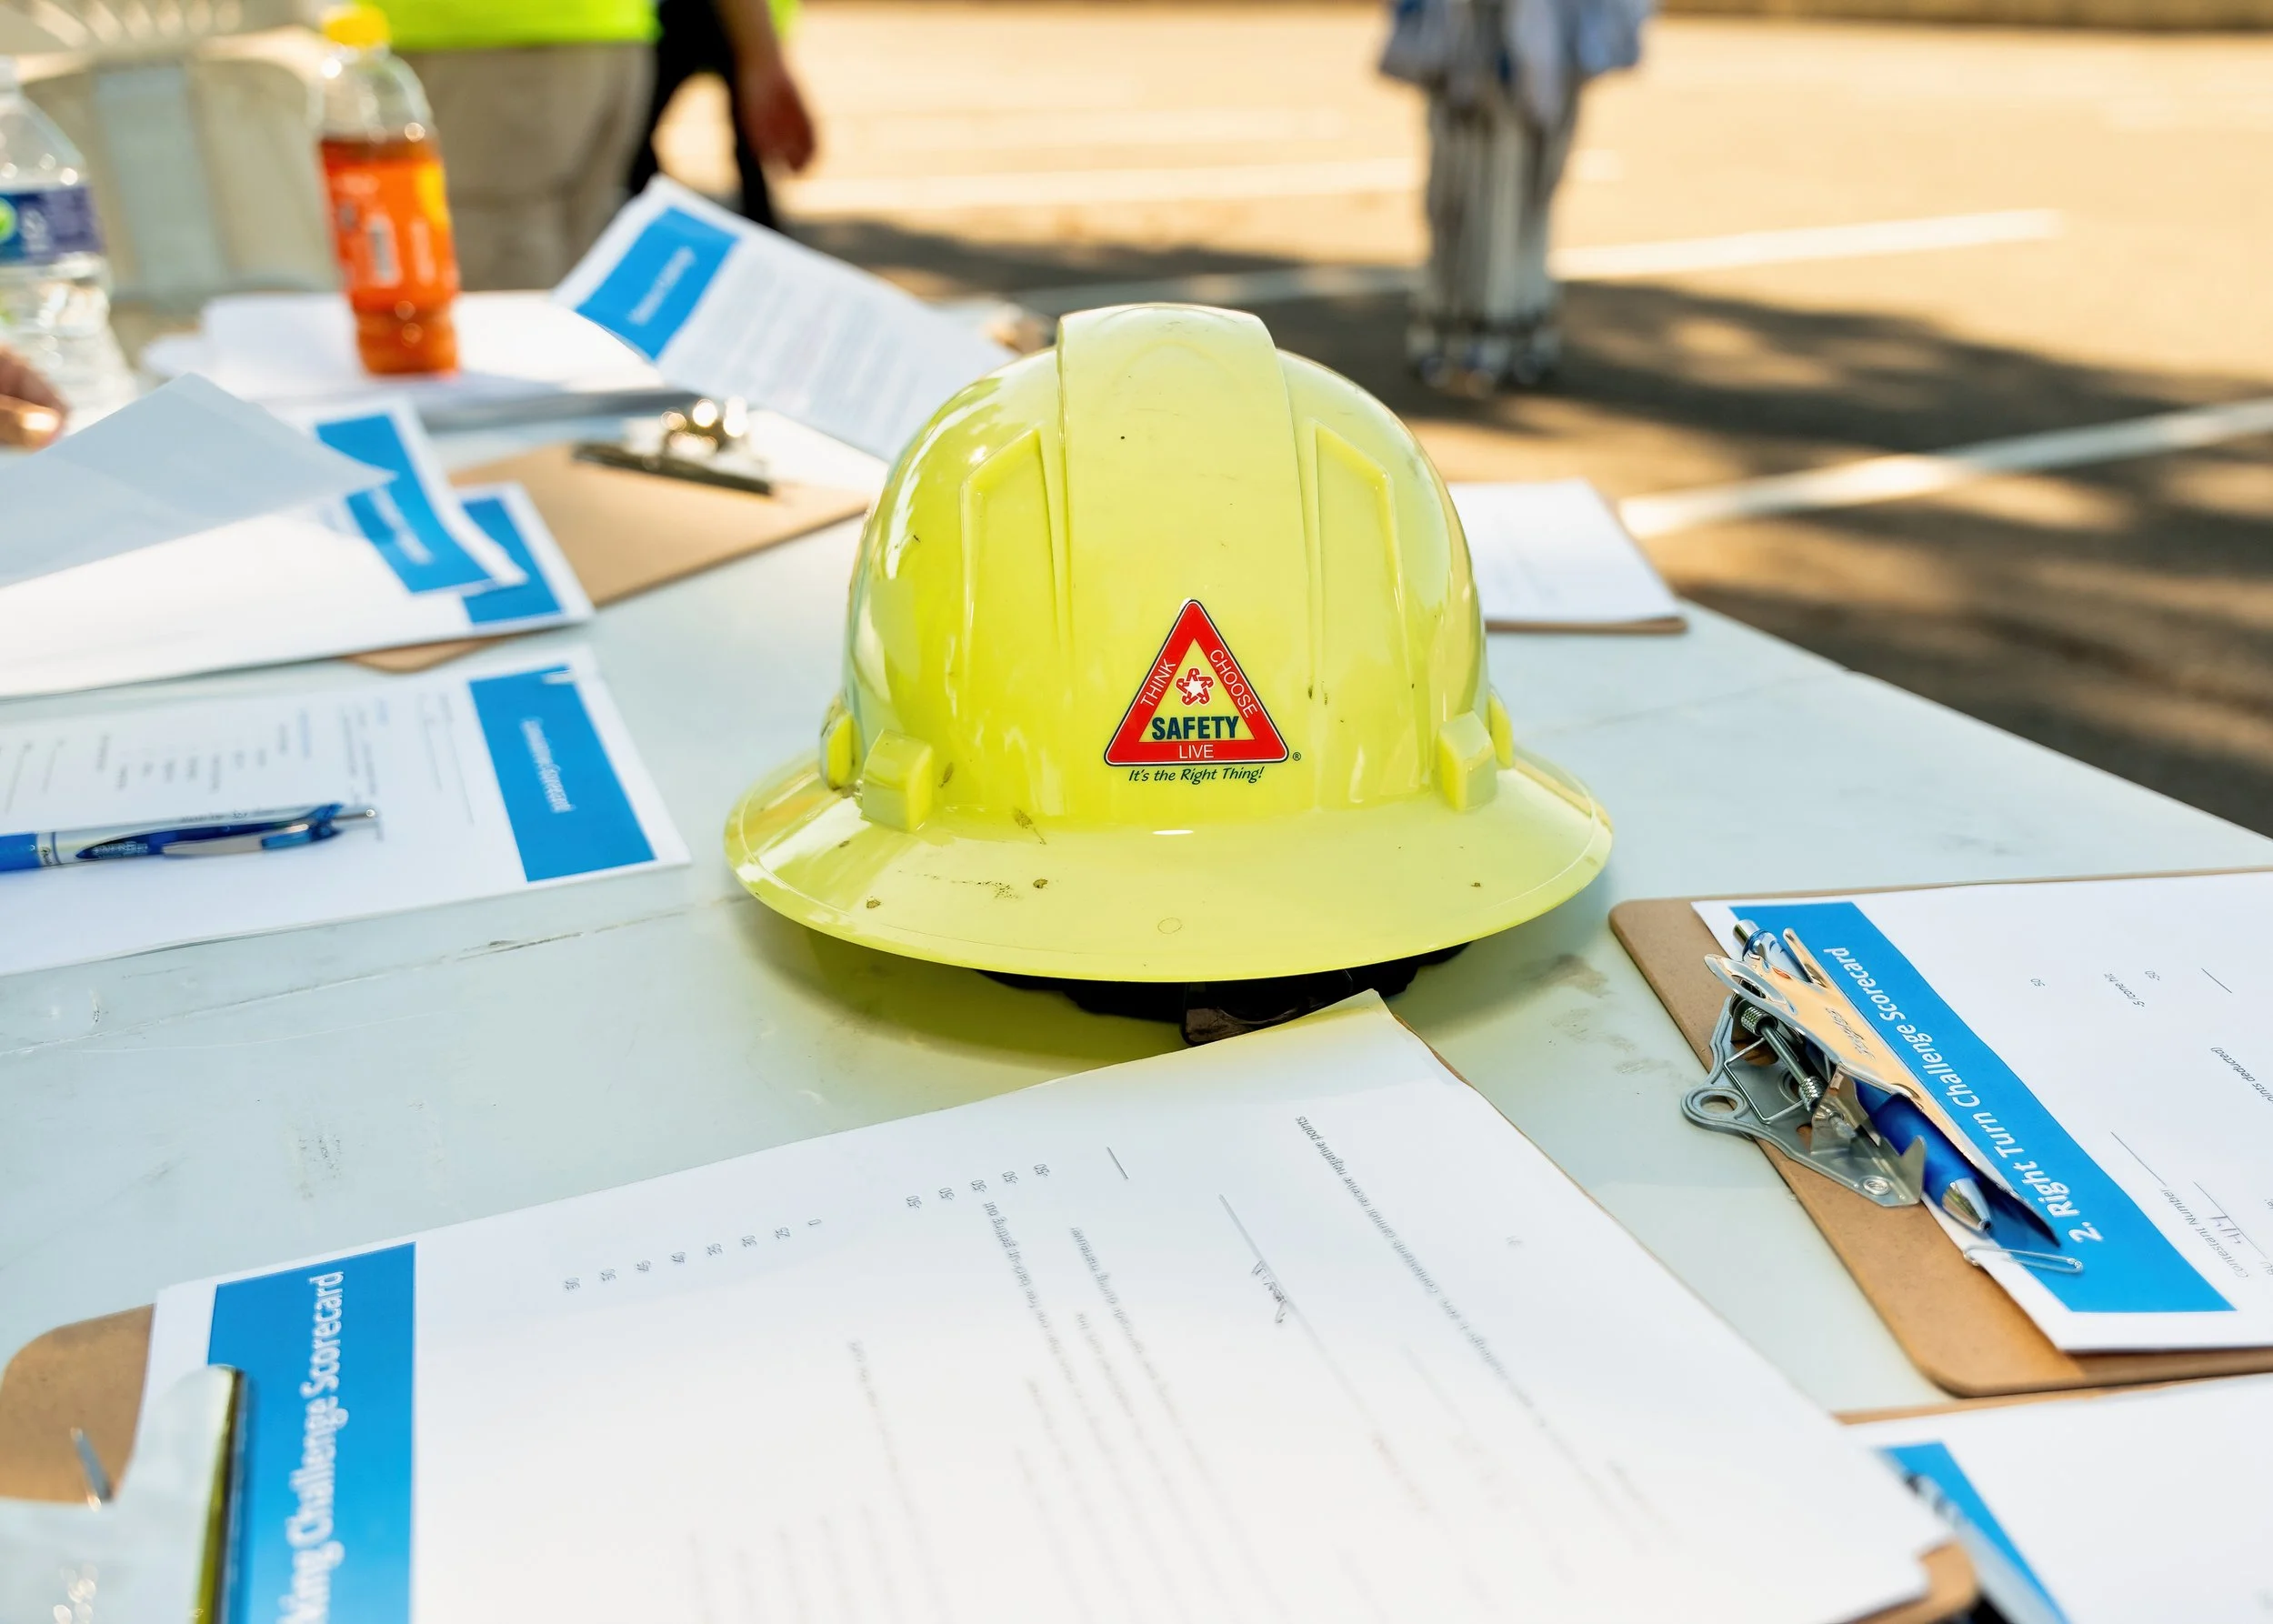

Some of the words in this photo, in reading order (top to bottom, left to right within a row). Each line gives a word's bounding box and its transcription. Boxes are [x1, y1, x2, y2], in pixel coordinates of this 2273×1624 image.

[1140, 658, 1177, 707] THINK
[1210, 649, 1258, 718] CHOOSE
[1152, 716, 1239, 740] SAFETY
[1179, 744, 1214, 759] LIVE
[1128, 768, 1150, 782] It's
[1154, 769, 1176, 781] the
[1180, 767, 1217, 785] Right
[1222, 767, 1265, 784] Thing!
[1823, 947, 1906, 1022] Scorecard
[1896, 1022, 1980, 1108] Challenge
[2210, 1048, 2256, 1082] deducted)
[2251, 1083, 2273, 1104] oints
[1295, 1115, 1325, 1141] points
[1971, 1111, 2025, 1158] Turn
[1315, 1140, 1347, 1176] negative
[1343, 1176, 1371, 1207] receive
[2013, 1159, 2080, 1217] Right
[983, 1201, 998, 1217] out
[1365, 1208, 1397, 1239] cannot
[2160, 1188, 2199, 1226] Number
[992, 1216, 1018, 1248] getting
[1070, 1227, 1099, 1271] maneuver
[2068, 1221, 2104, 1243] 2.
[2196, 1226, 2248, 1278] Contestant
[299, 1271, 345, 1398] Scorecard
[285, 1394, 349, 1548] Challenge
